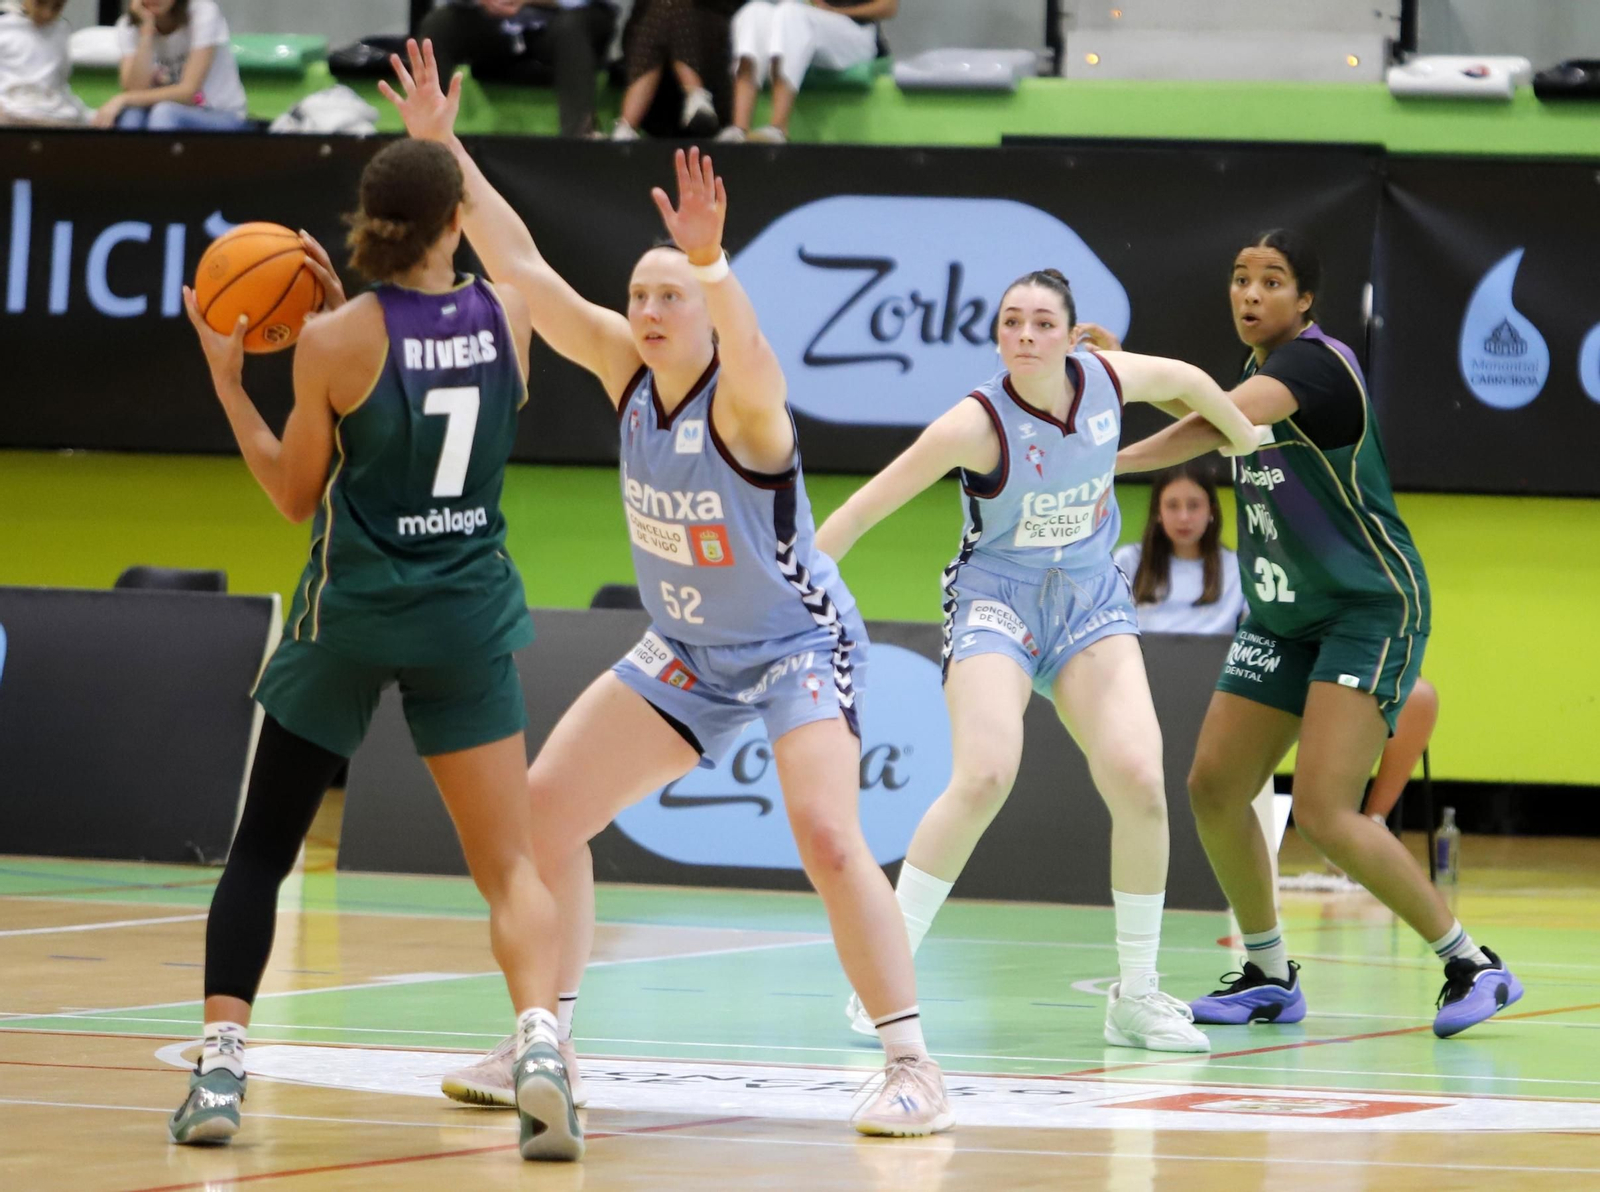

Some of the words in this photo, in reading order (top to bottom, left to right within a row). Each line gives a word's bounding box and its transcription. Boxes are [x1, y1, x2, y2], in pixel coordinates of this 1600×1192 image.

[798, 243, 1001, 375] Zork
[403, 329, 498, 371] RIVERS
[423, 386, 481, 498] 7
[650, 535, 679, 554] VIGO
[1029, 527, 1046, 538] DE
[1050, 525, 1082, 537] VIGO
[1254, 556, 1296, 603] 32
[660, 580, 705, 625] 52
[974, 605, 1025, 630] CONCELLO
[979, 613, 993, 623] DE
[997, 617, 1018, 635] VIGO
[1224, 665, 1264, 683] DENTAL
